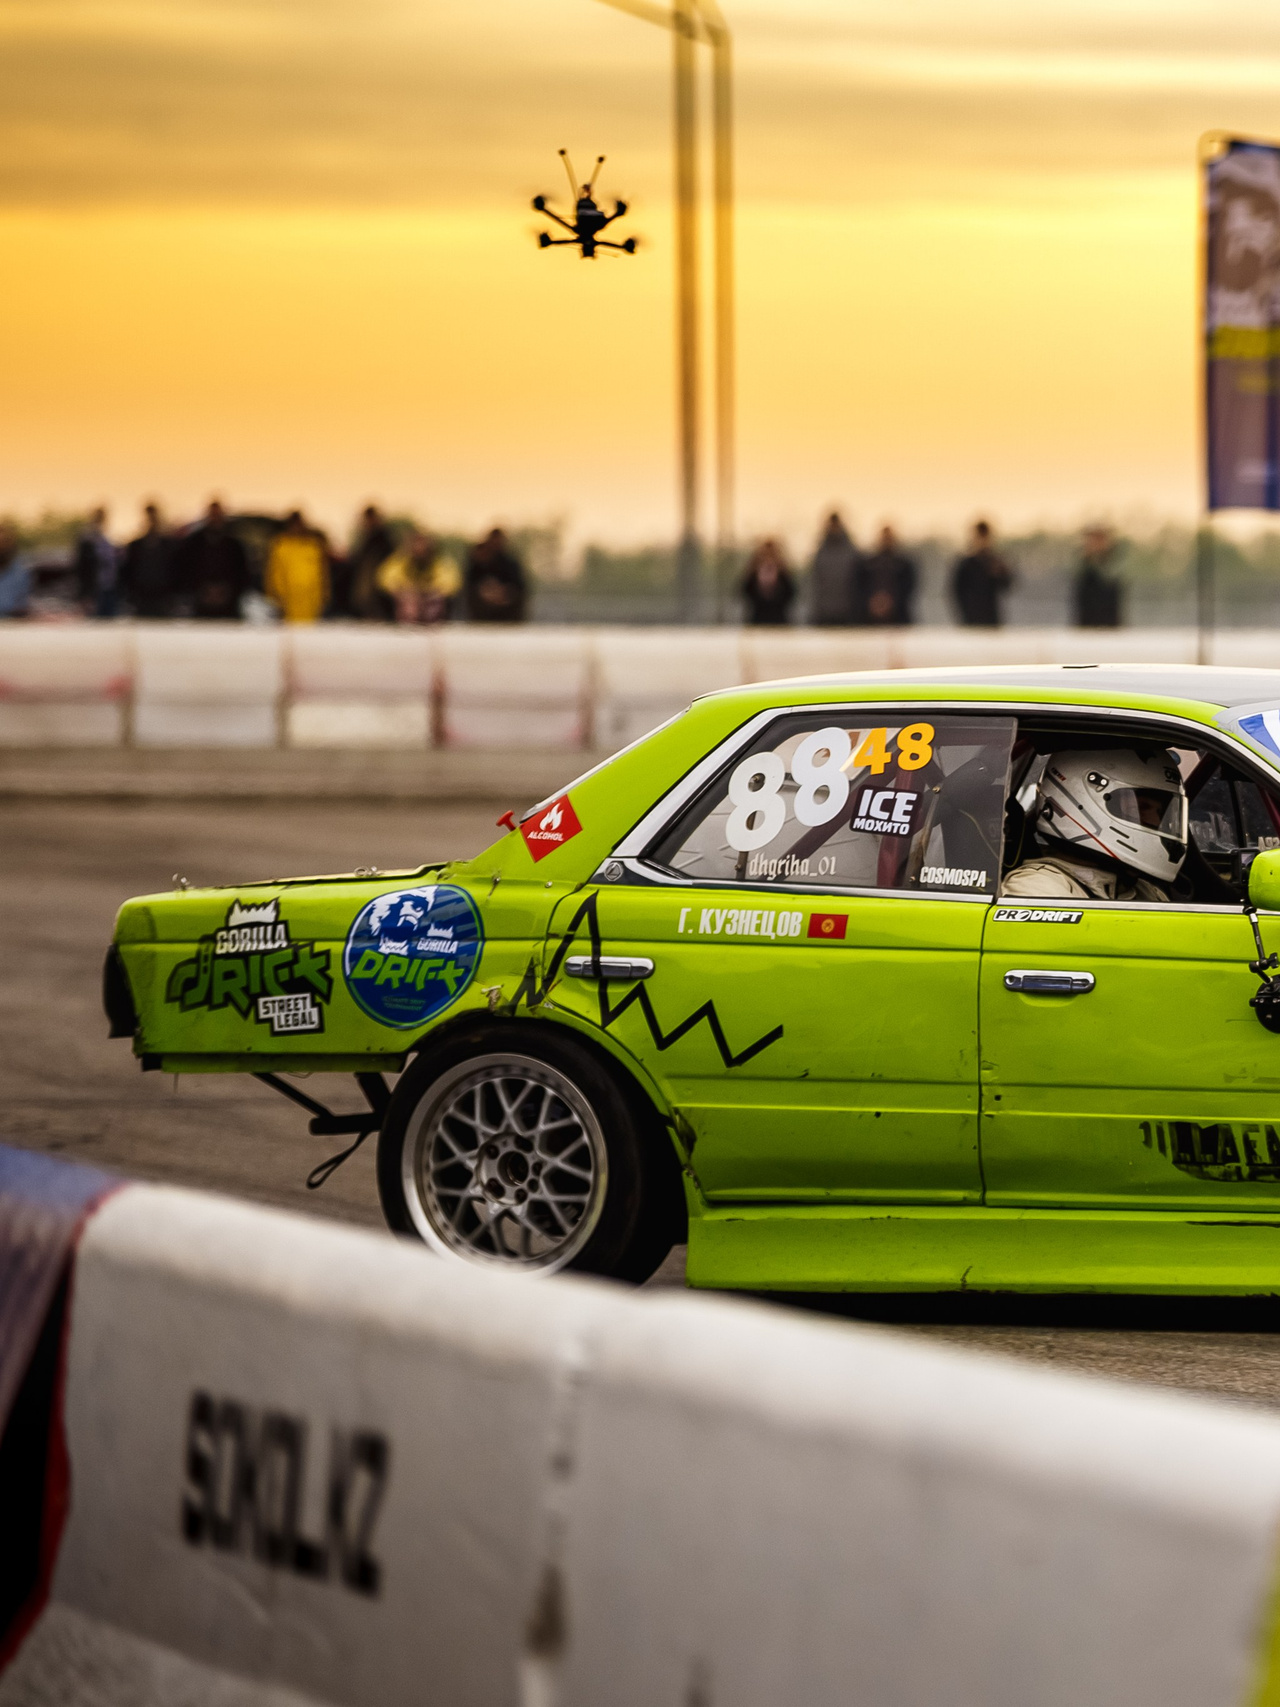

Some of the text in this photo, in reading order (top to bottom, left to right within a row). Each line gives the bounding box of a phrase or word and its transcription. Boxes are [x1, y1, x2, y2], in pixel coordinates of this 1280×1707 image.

[853, 723, 935, 771] 48
[725, 727, 852, 852] 88
[857, 789, 918, 822] ICE
[527, 831, 565, 842] ALCOHOL
[852, 818, 910, 836] МОХИТО
[920, 866, 987, 888] COSMOSPA
[678, 908, 803, 939] Г. КУЗНЕЦОВ
[216, 923, 289, 955] GORILLA
[417, 938, 458, 954] GORILLA
[262, 998, 308, 1015] STREET
[277, 1009, 316, 1028] LEGAL
